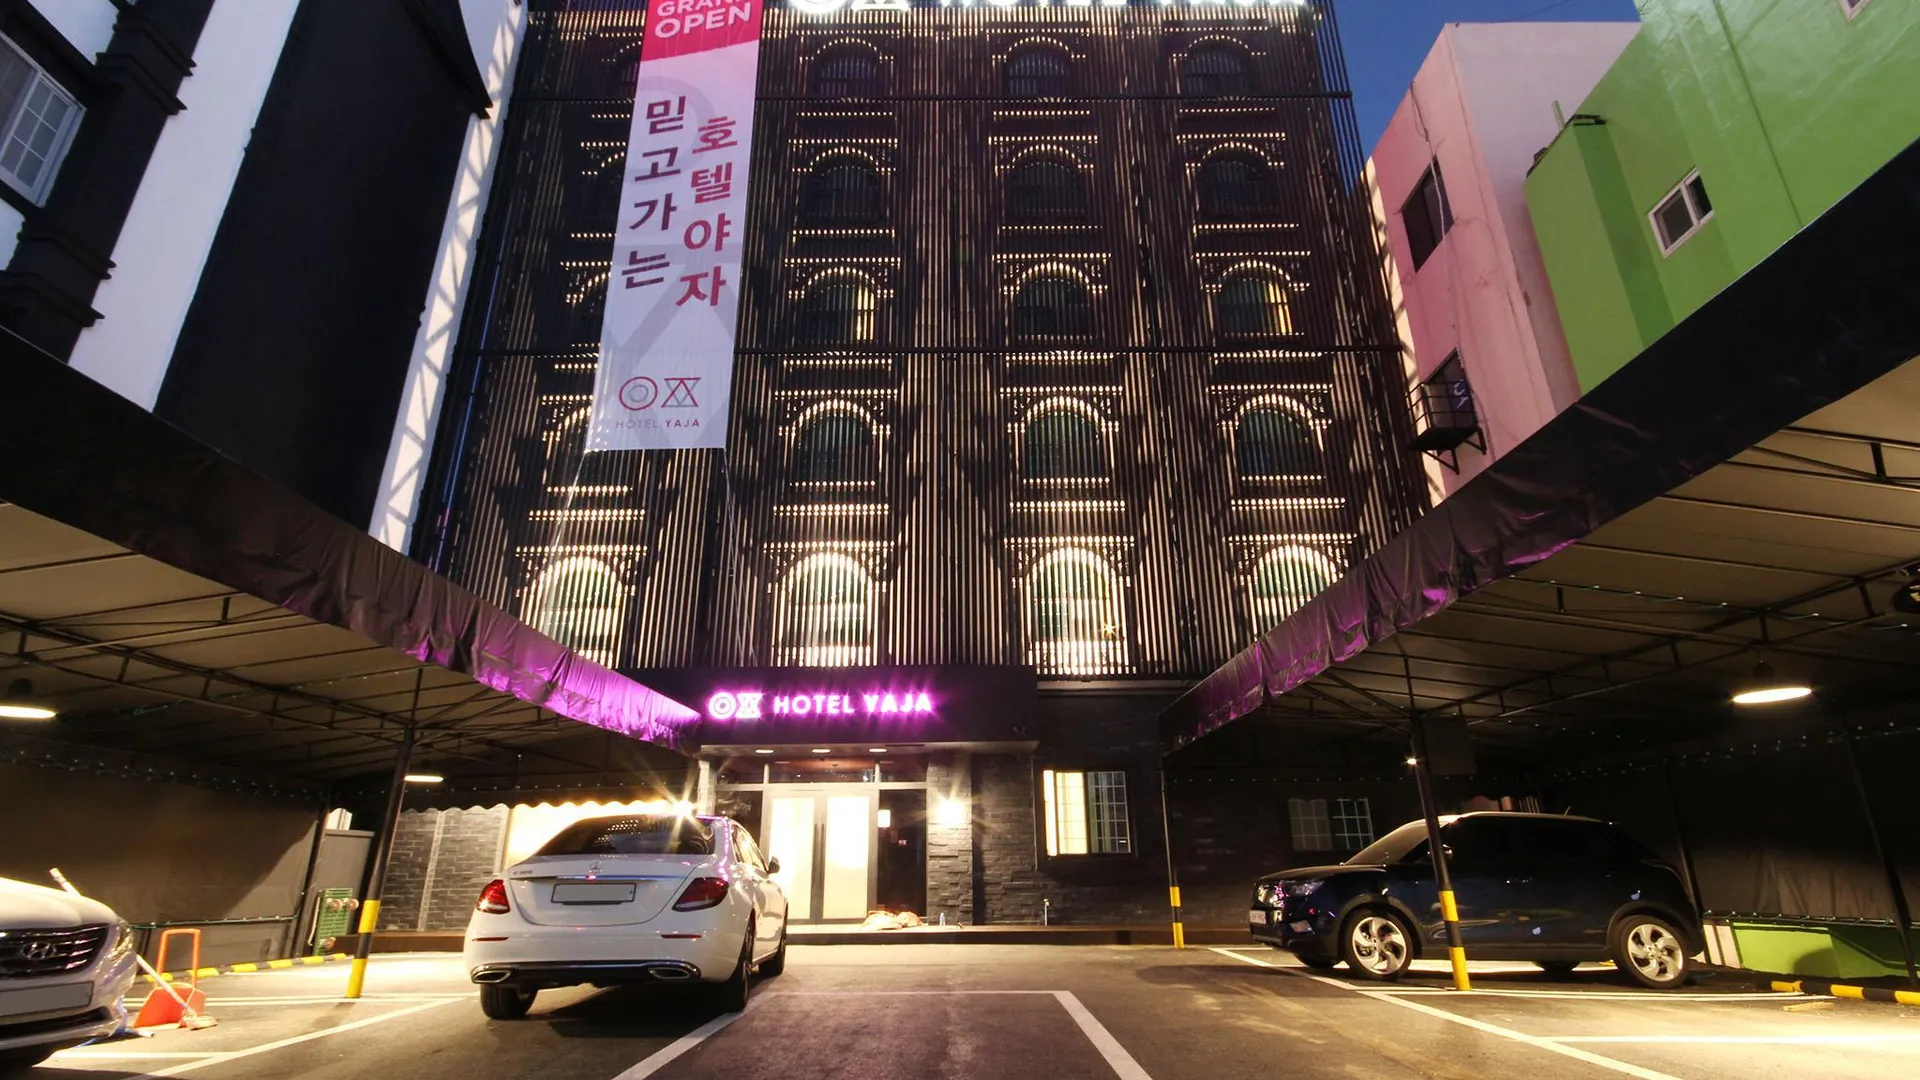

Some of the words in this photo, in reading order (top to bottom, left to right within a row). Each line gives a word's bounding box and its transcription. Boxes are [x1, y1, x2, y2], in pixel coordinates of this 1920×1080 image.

[657, 0, 741, 17] GRA
[655, 2, 750, 38] OPEN
[675, 116, 738, 307] 호텔야자
[615, 419, 658, 429] HOTEL
[665, 418, 700, 428] YAJA
[773, 694, 855, 714] HOTEL
[863, 692, 932, 713] YAJA
